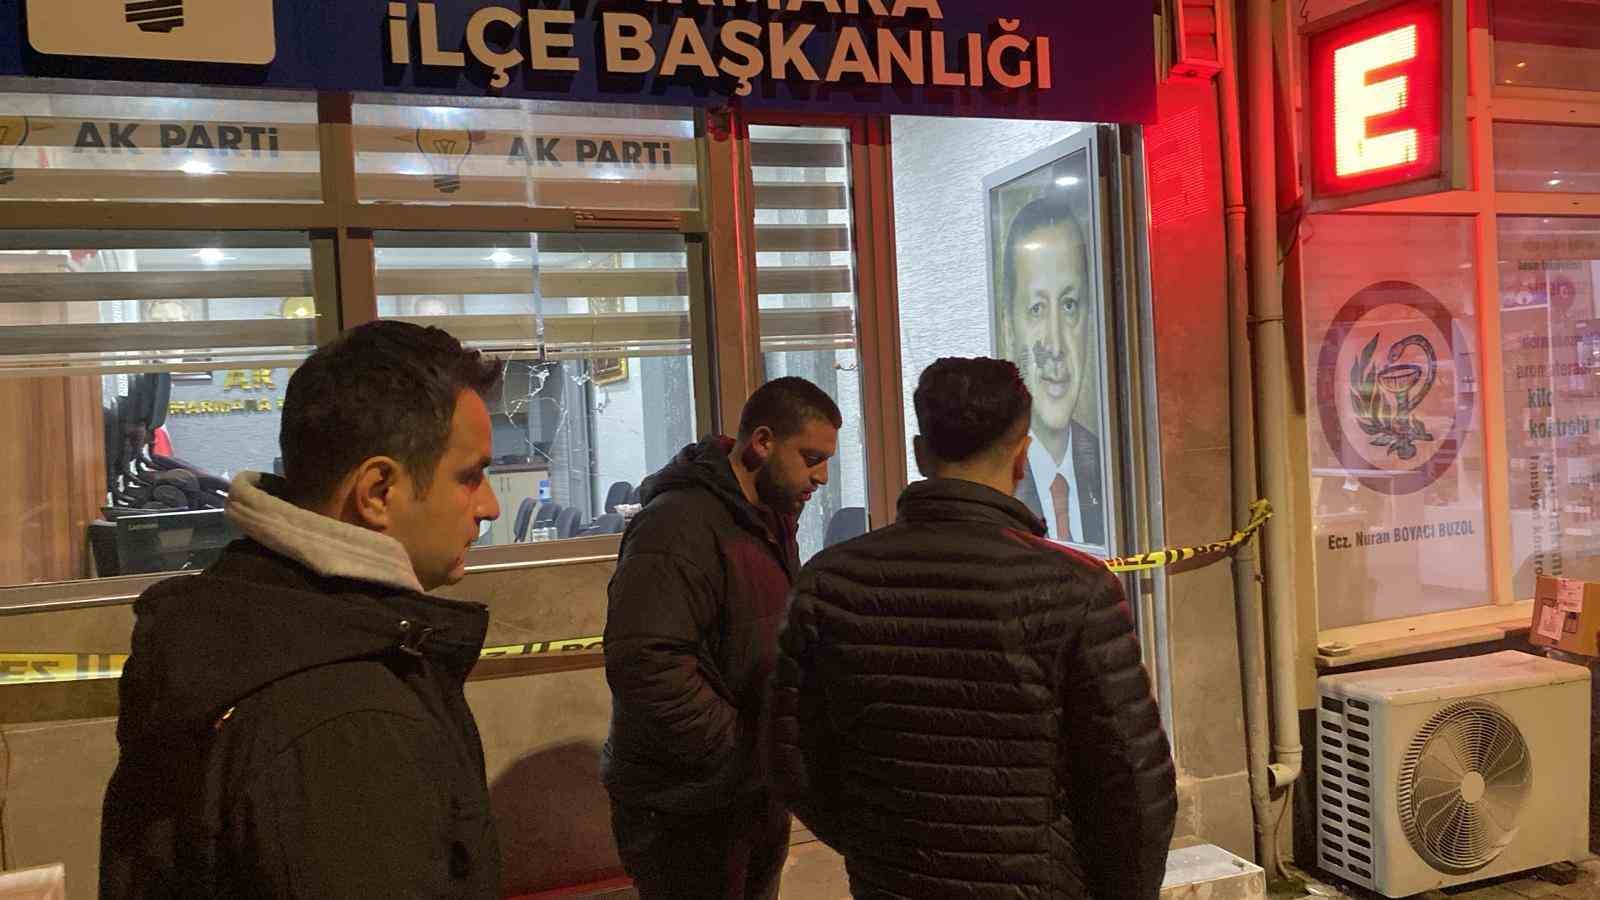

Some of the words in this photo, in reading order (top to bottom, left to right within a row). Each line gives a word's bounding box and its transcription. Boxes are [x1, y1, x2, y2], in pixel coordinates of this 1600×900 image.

[388, 2, 580, 88] İLÇE
[602, 12, 1051, 97] BAŞKANLIĞI
[1334, 24, 1417, 177] E
[74, 121, 142, 153] AK
[507, 136, 562, 167] AK
[1328, 534, 1352, 550] Ecz.
[1355, 531, 1391, 546] Nuran
[1394, 524, 1435, 542] BOYACI
